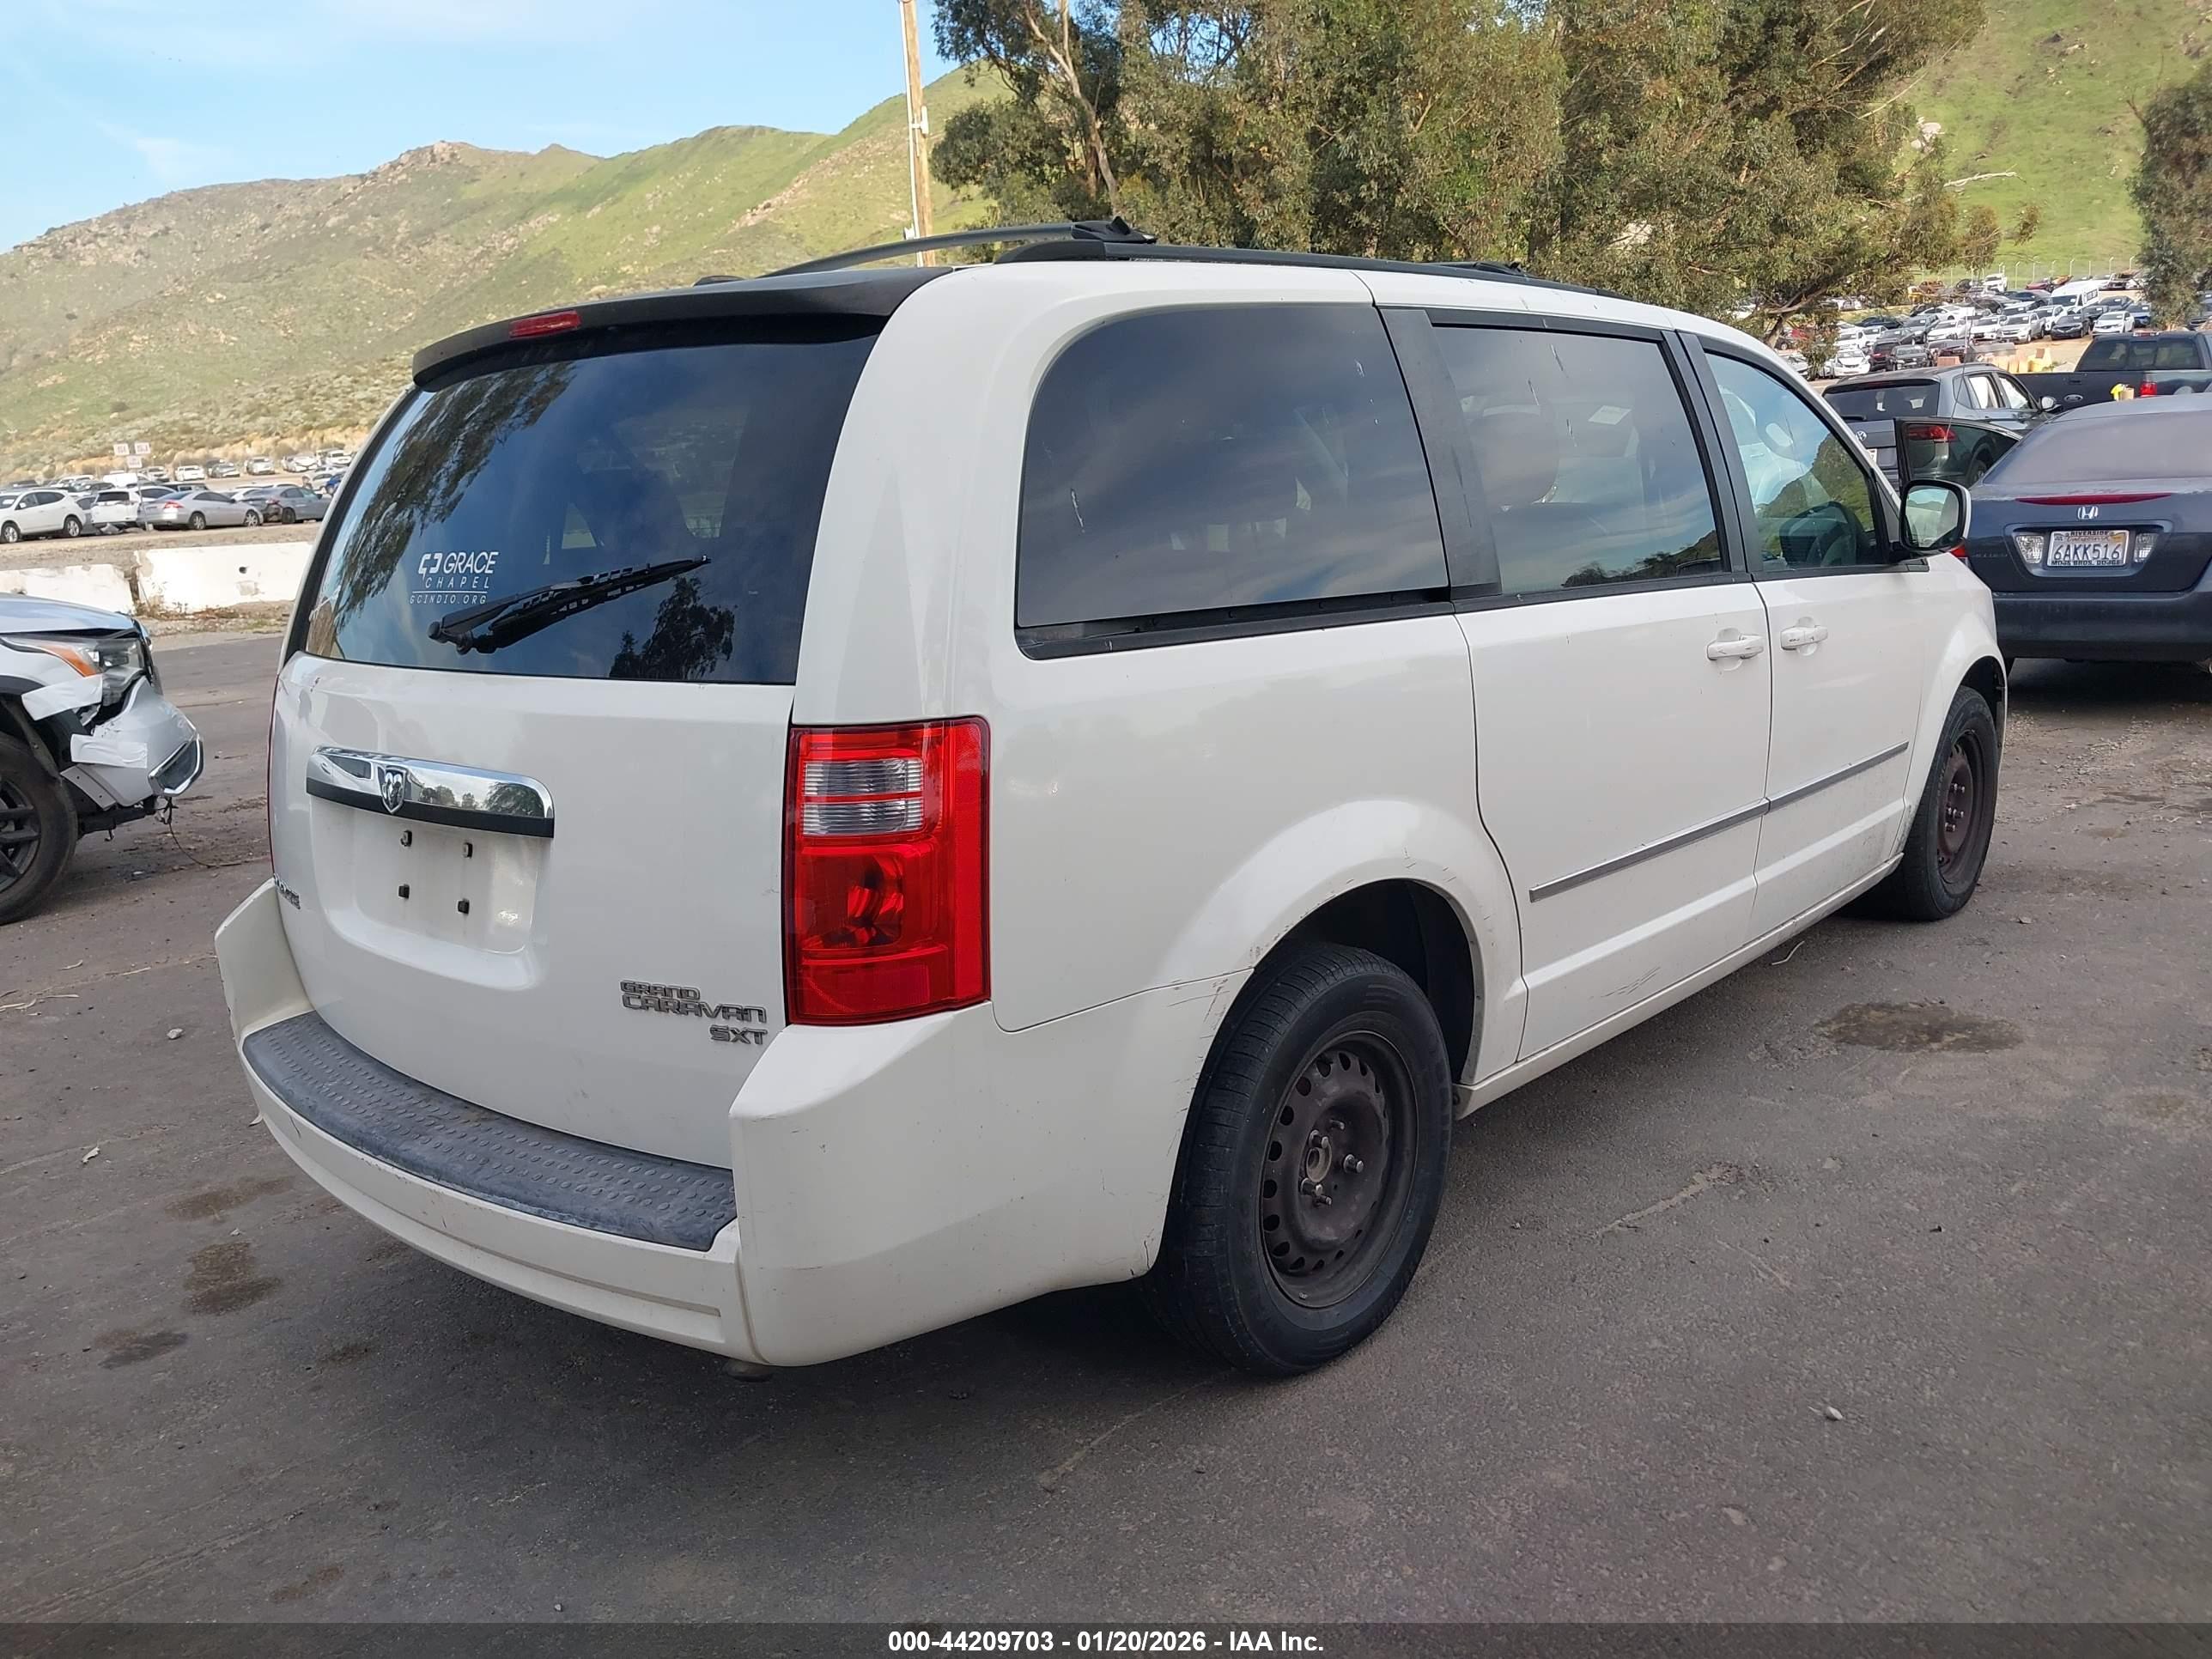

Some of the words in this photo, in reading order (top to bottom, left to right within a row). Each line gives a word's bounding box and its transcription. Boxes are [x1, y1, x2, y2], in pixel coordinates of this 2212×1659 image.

[443, 551, 499, 574] GRACE
[2053, 544, 2122, 561] 6AKK516
[425, 576, 489, 588] CHAPEL
[410, 594, 487, 605] GCINDIO.ORG
[620, 980, 700, 1000] GRAND
[622, 993, 767, 1024] CARAVAN
[709, 1024, 768, 1045] SXT
